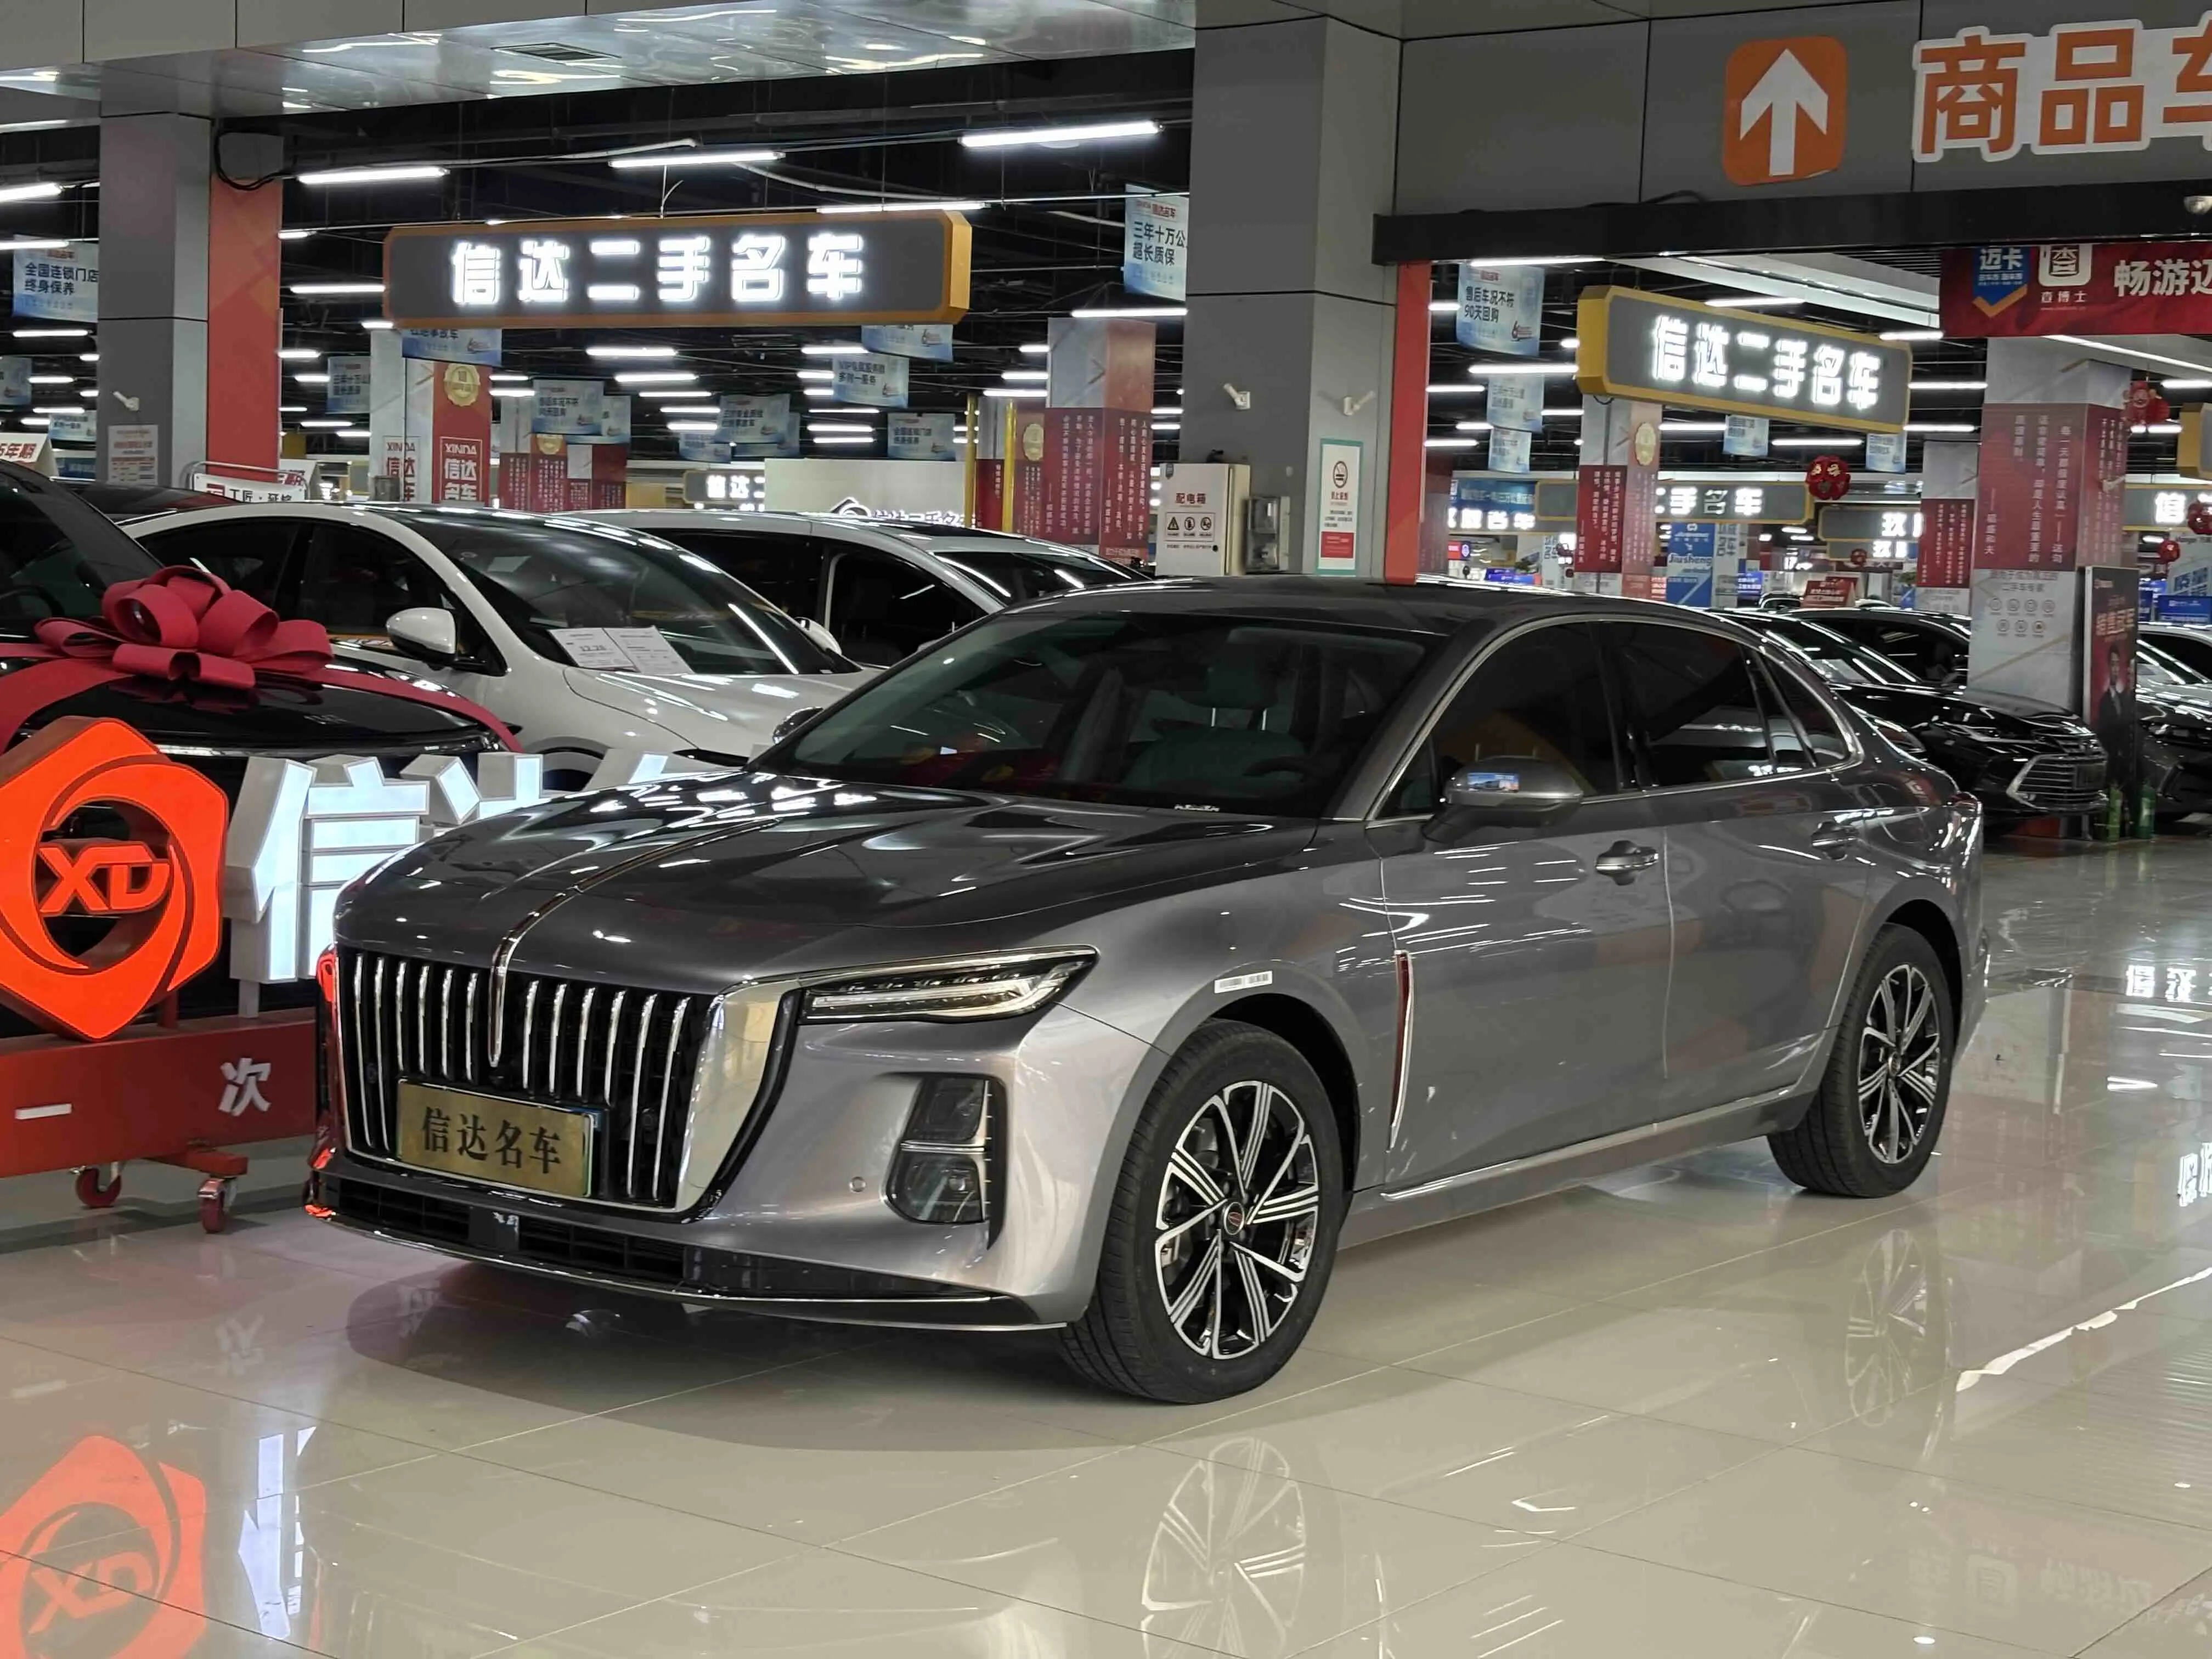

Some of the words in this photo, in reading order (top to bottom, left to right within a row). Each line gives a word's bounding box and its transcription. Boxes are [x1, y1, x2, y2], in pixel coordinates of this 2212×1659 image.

[452, 233, 862, 304] 信达二手名车
[1979, 246, 2023, 270] 迈卡
[25, 262, 99, 282] 全国连锁门店
[25, 279, 75, 295] 终身保养
[1651, 315, 1880, 410] 信达二手名车
[445, 443, 477, 455] XINDA
[387, 457, 415, 477] 信达
[444, 458, 477, 481] 信达
[40, 844, 170, 913] XD
[220, 1057, 272, 1116] 次
[422, 1106, 562, 1174] 信达名车
